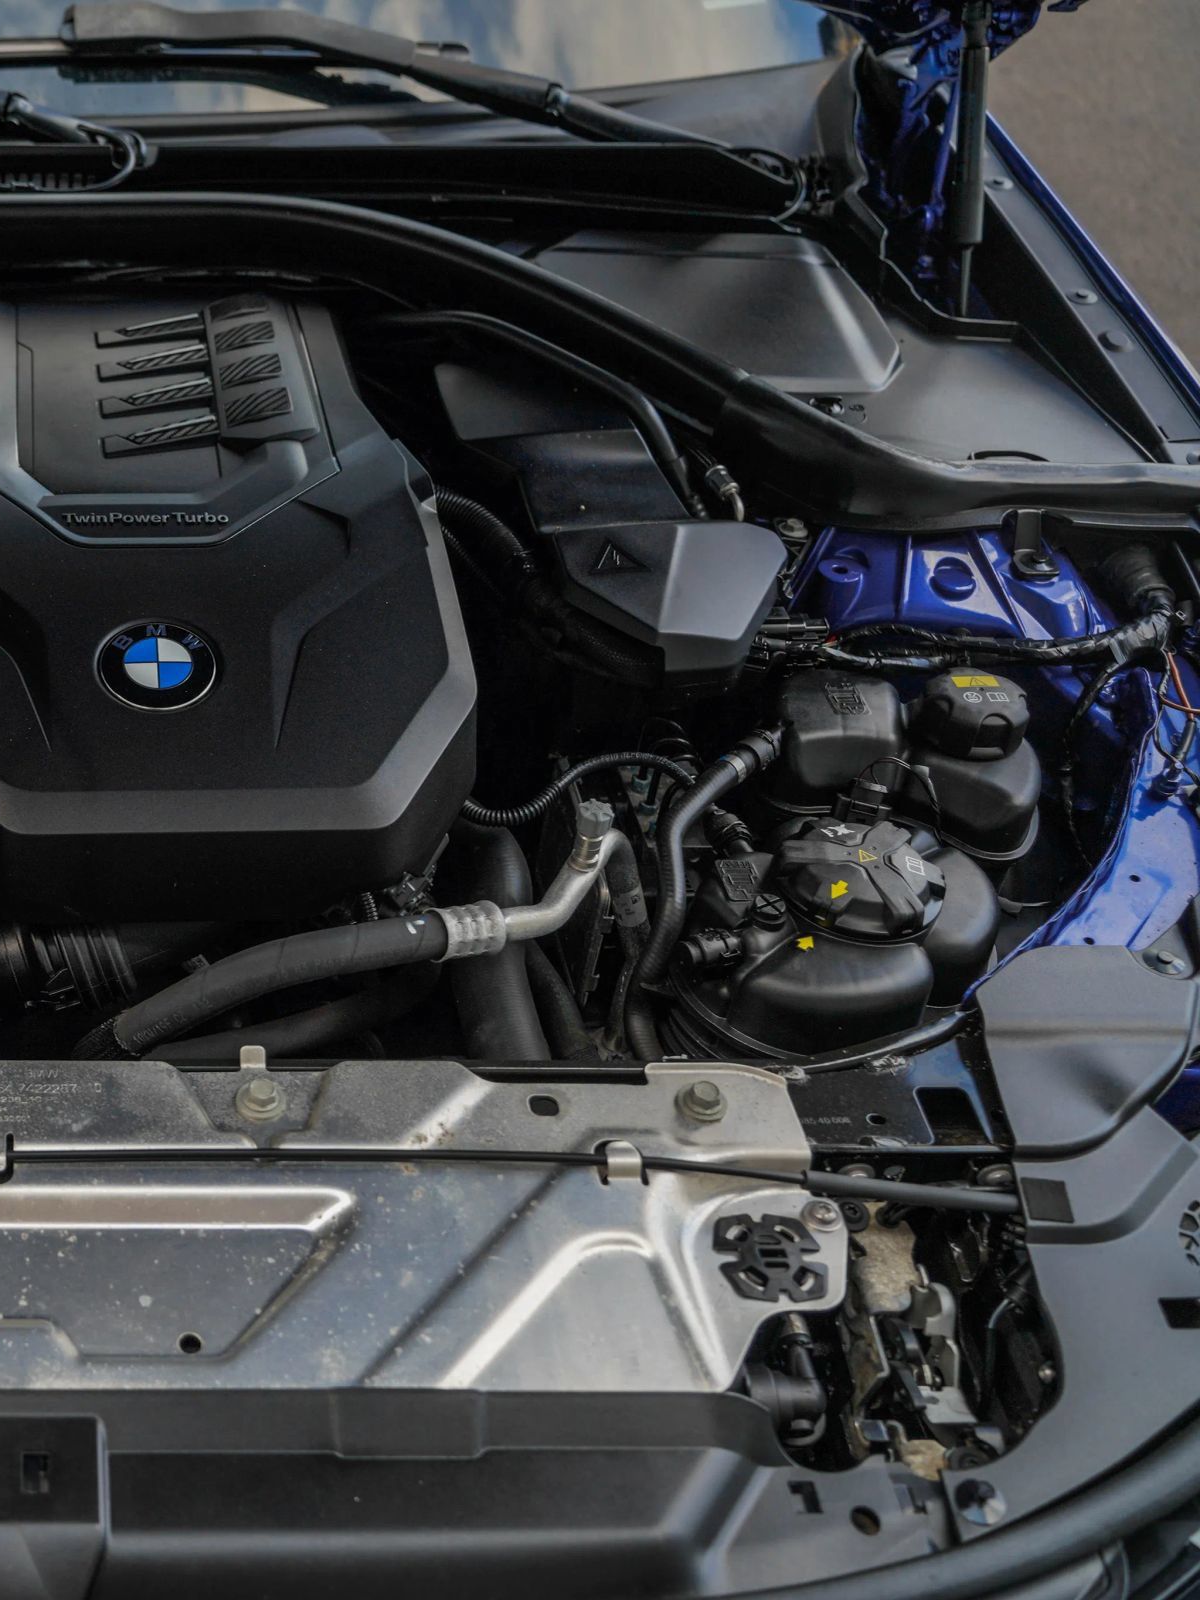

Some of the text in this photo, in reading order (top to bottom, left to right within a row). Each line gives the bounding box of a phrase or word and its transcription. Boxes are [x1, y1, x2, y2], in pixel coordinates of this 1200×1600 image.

[62, 511, 230, 524] TwinPower Turbo
[112, 623, 203, 651] BMW
